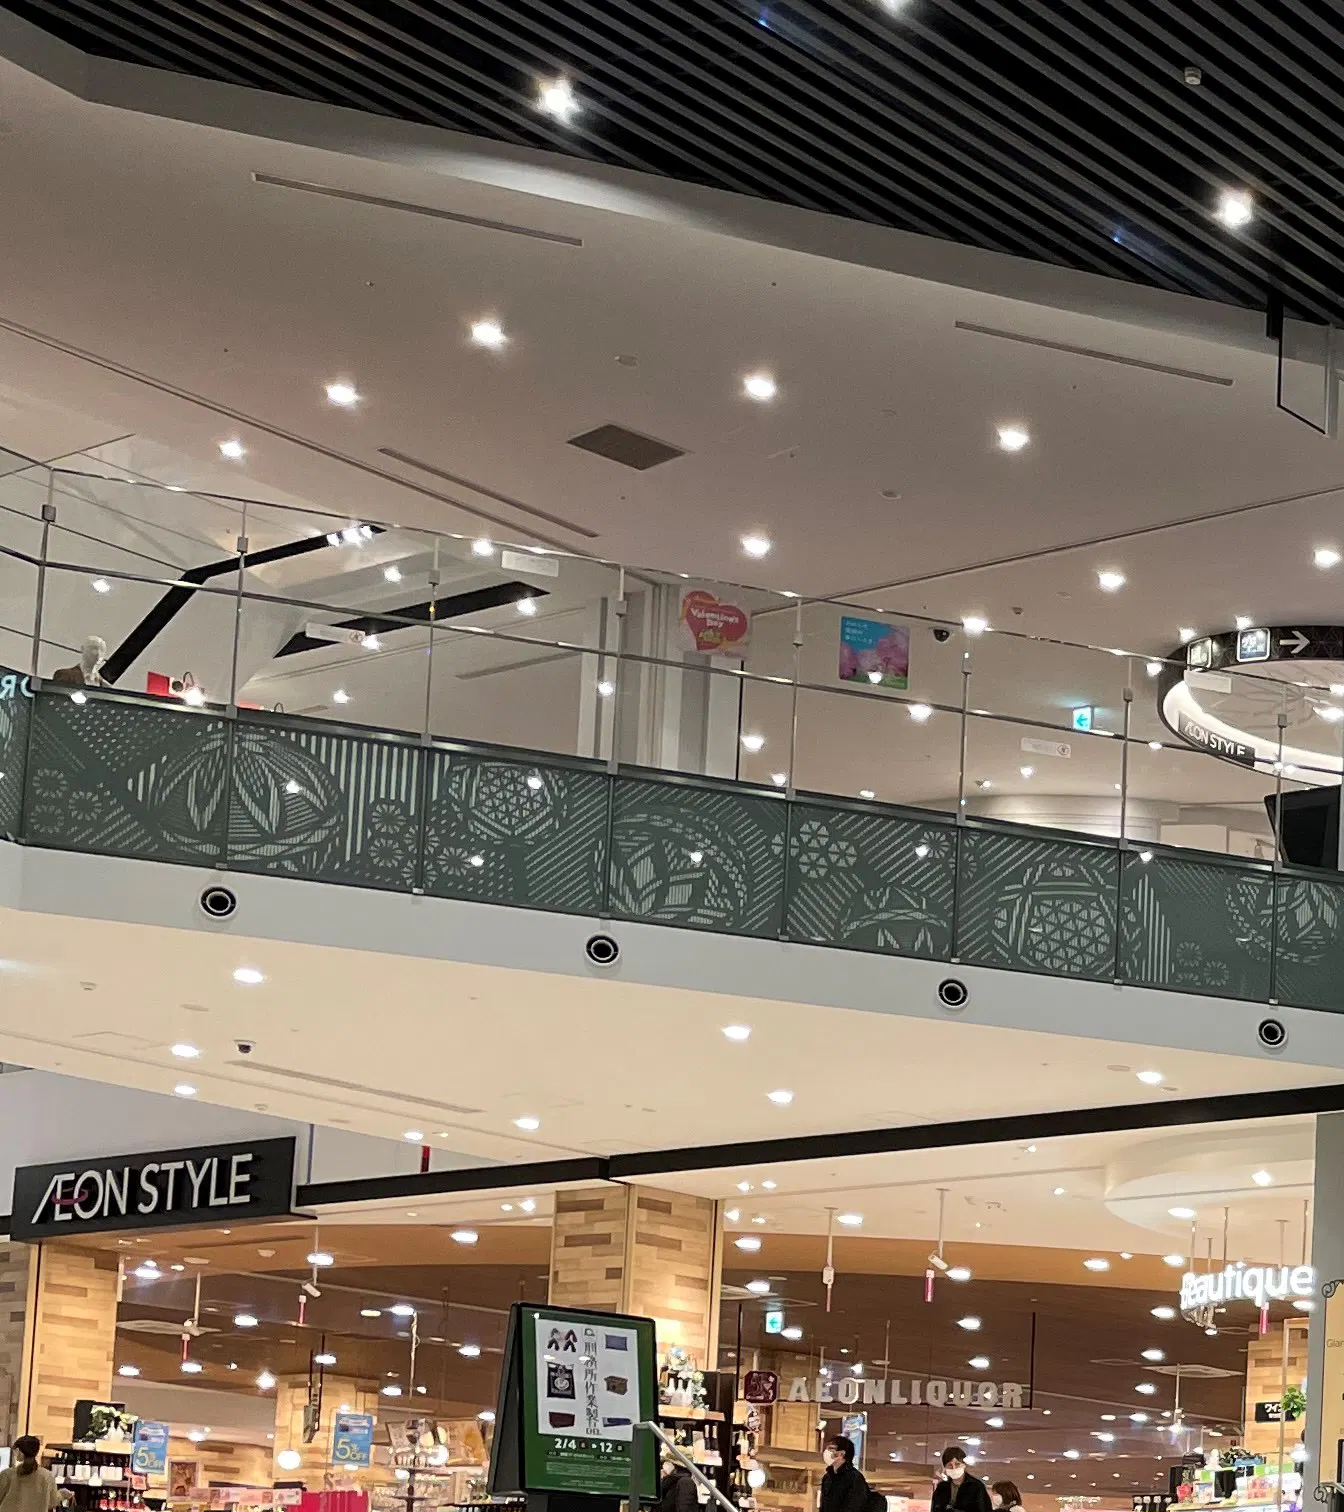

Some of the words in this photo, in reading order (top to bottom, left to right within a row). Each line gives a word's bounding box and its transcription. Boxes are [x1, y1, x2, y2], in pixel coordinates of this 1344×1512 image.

[137, 1153, 253, 1214] STYLE
[554, 1438, 577, 1450] 2/4
[599, 1442, 613, 1453] 12
